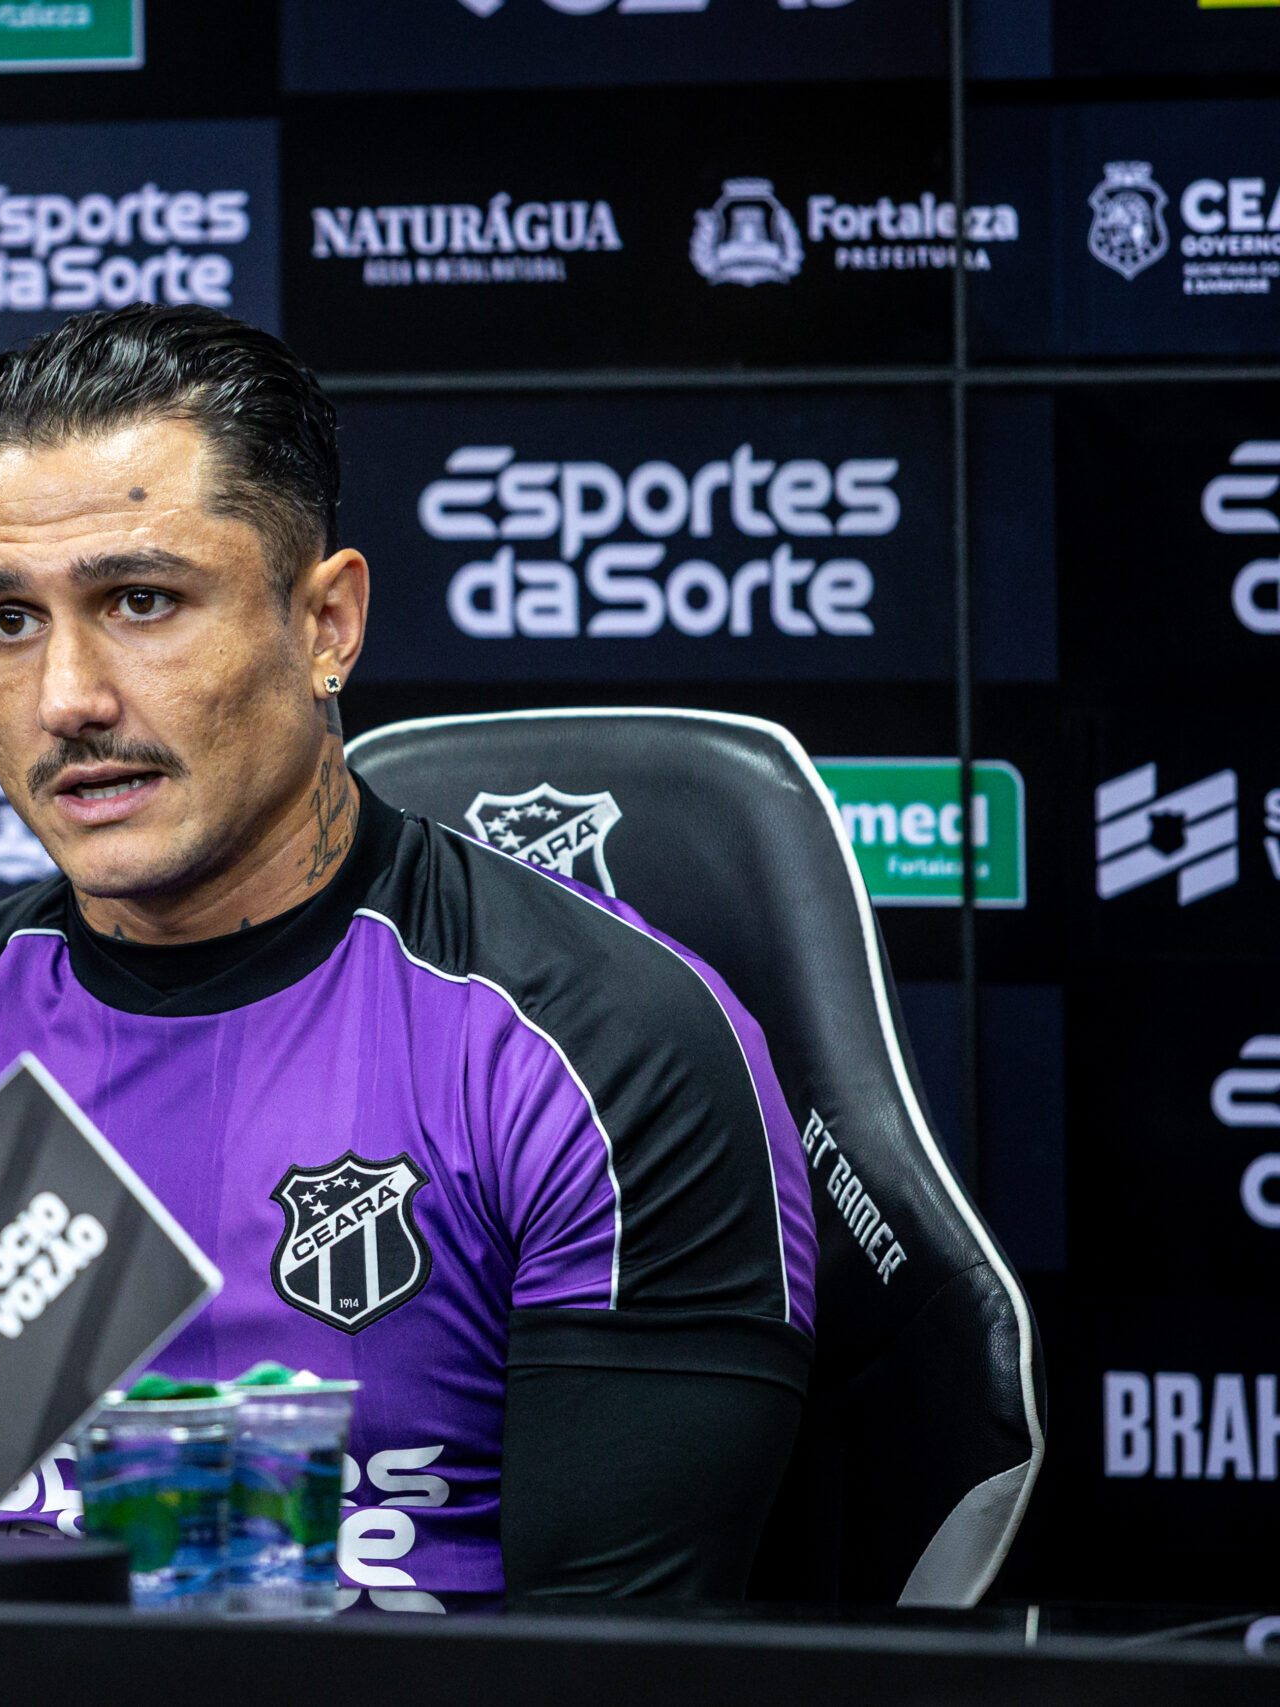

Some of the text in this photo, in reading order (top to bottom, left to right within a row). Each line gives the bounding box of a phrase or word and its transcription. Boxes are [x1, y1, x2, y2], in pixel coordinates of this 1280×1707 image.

[311, 192, 623, 258] NATURÁGUA
[808, 192, 1019, 241] Fortaleza
[418, 443, 901, 560] Esportes
[886, 854, 991, 879] Fortalea
[292, 1178, 401, 1261] CEARÁ
[802, 1107, 908, 1286] GT GAMER
[338, 1298, 360, 1309] 1914
